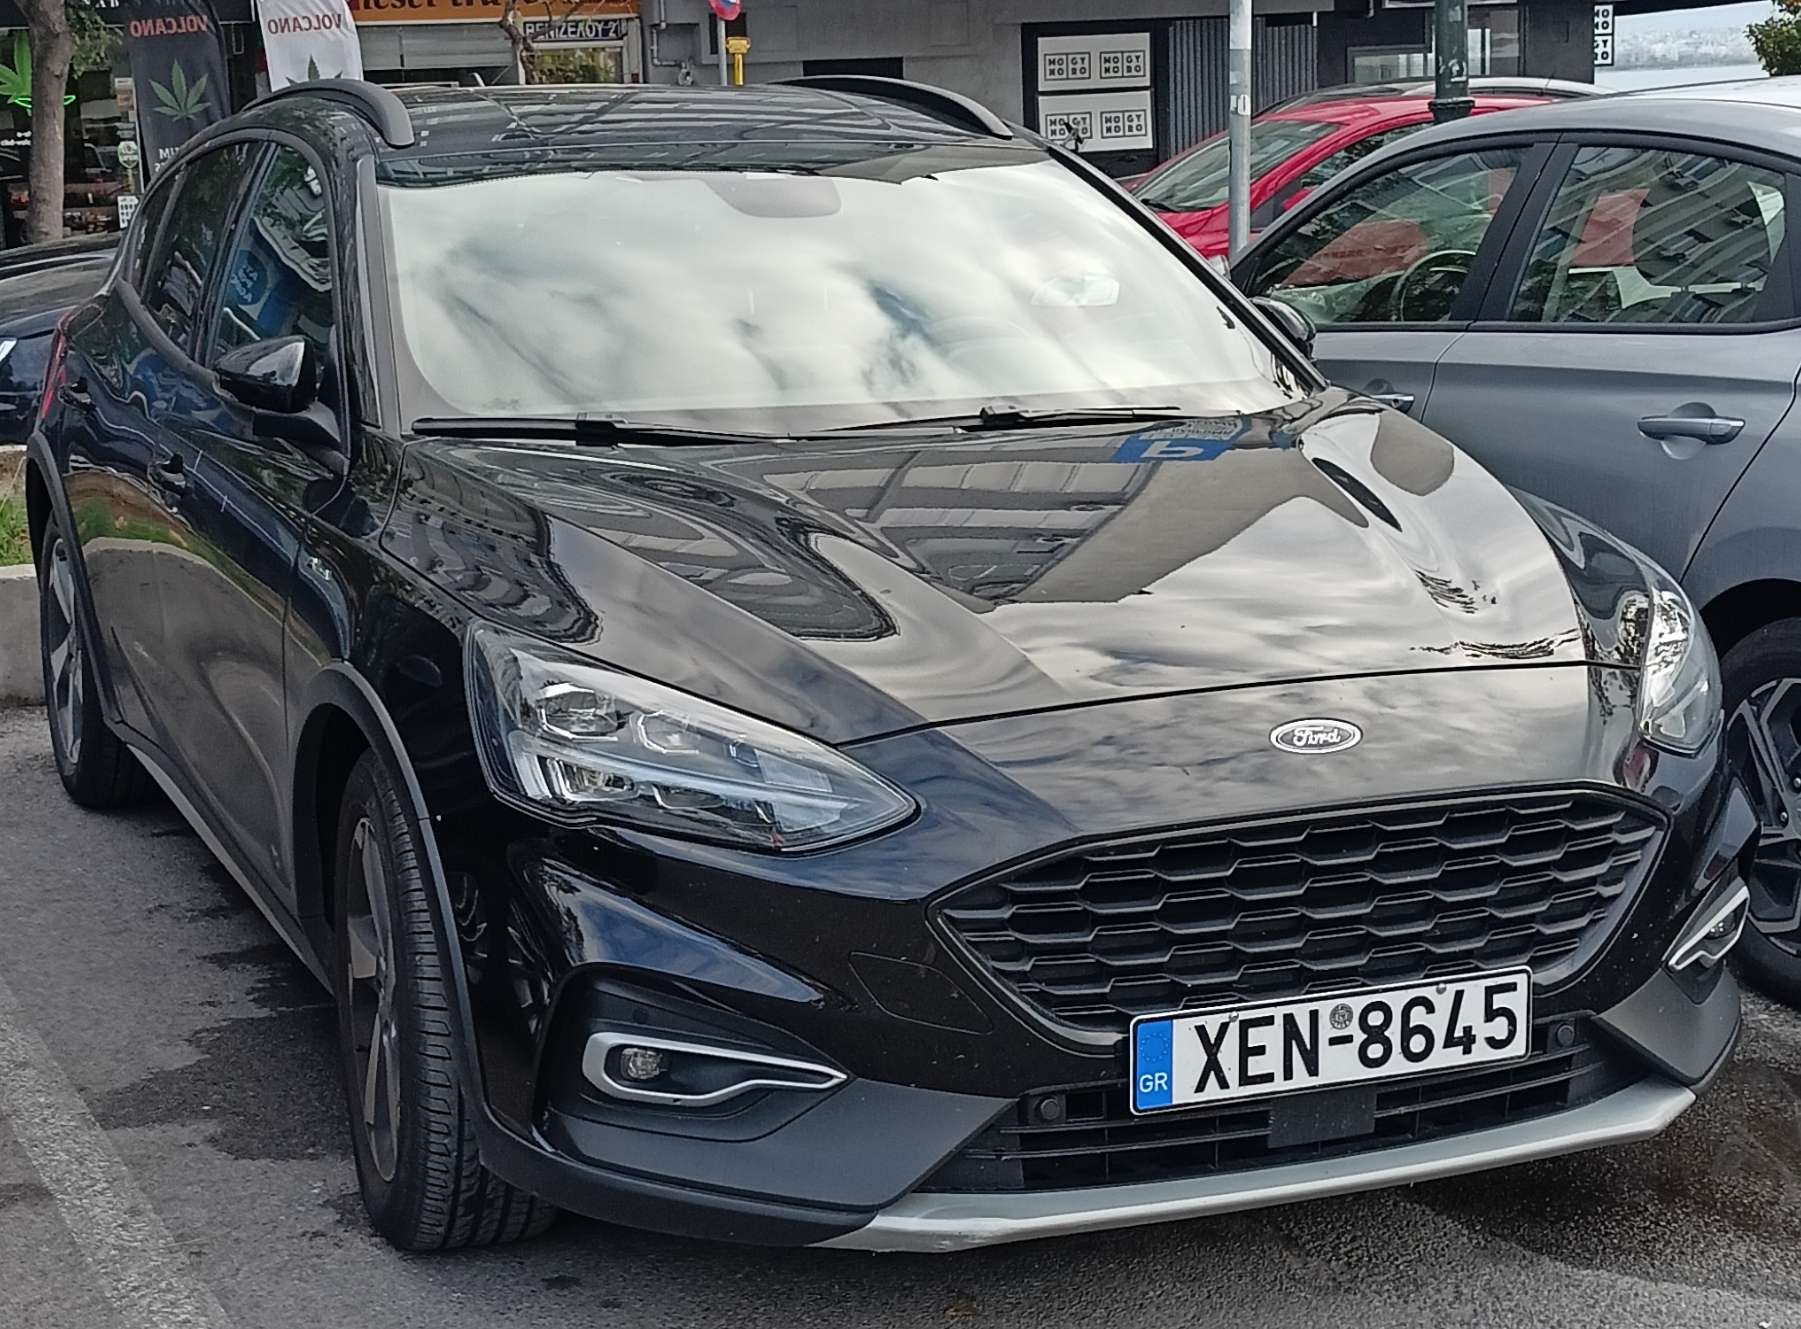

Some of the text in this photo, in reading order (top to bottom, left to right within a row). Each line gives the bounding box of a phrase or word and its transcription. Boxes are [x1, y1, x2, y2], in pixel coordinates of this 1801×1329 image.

[1293, 726, 1342, 747] Ford
[1193, 981, 1520, 1094] XEN-8645
[1138, 1071, 1169, 1094] GR
